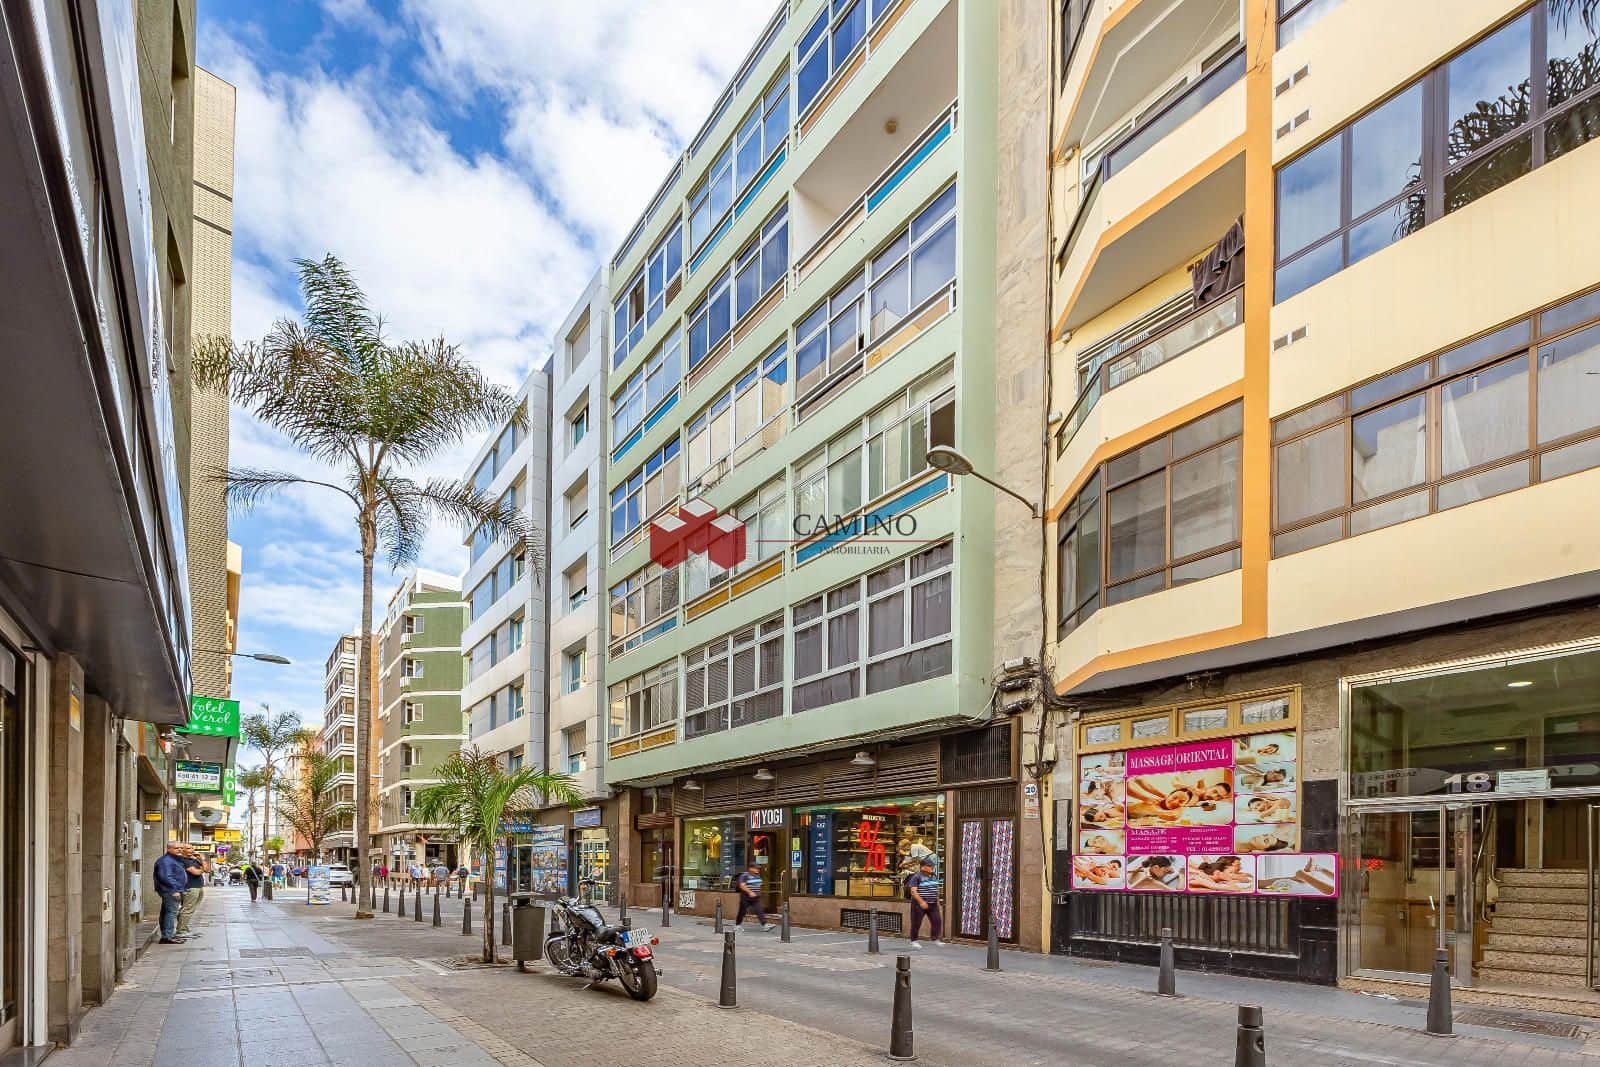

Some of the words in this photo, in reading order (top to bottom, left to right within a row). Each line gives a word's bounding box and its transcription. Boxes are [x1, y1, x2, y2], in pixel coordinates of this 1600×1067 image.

[1130, 754, 1174, 769] MASSAGE
[1176, 748, 1229, 764] ORIENTAL
[1025, 786, 1036, 794] 20
[1444, 773, 1492, 793] 18
[761, 808, 783, 825] YOGI
